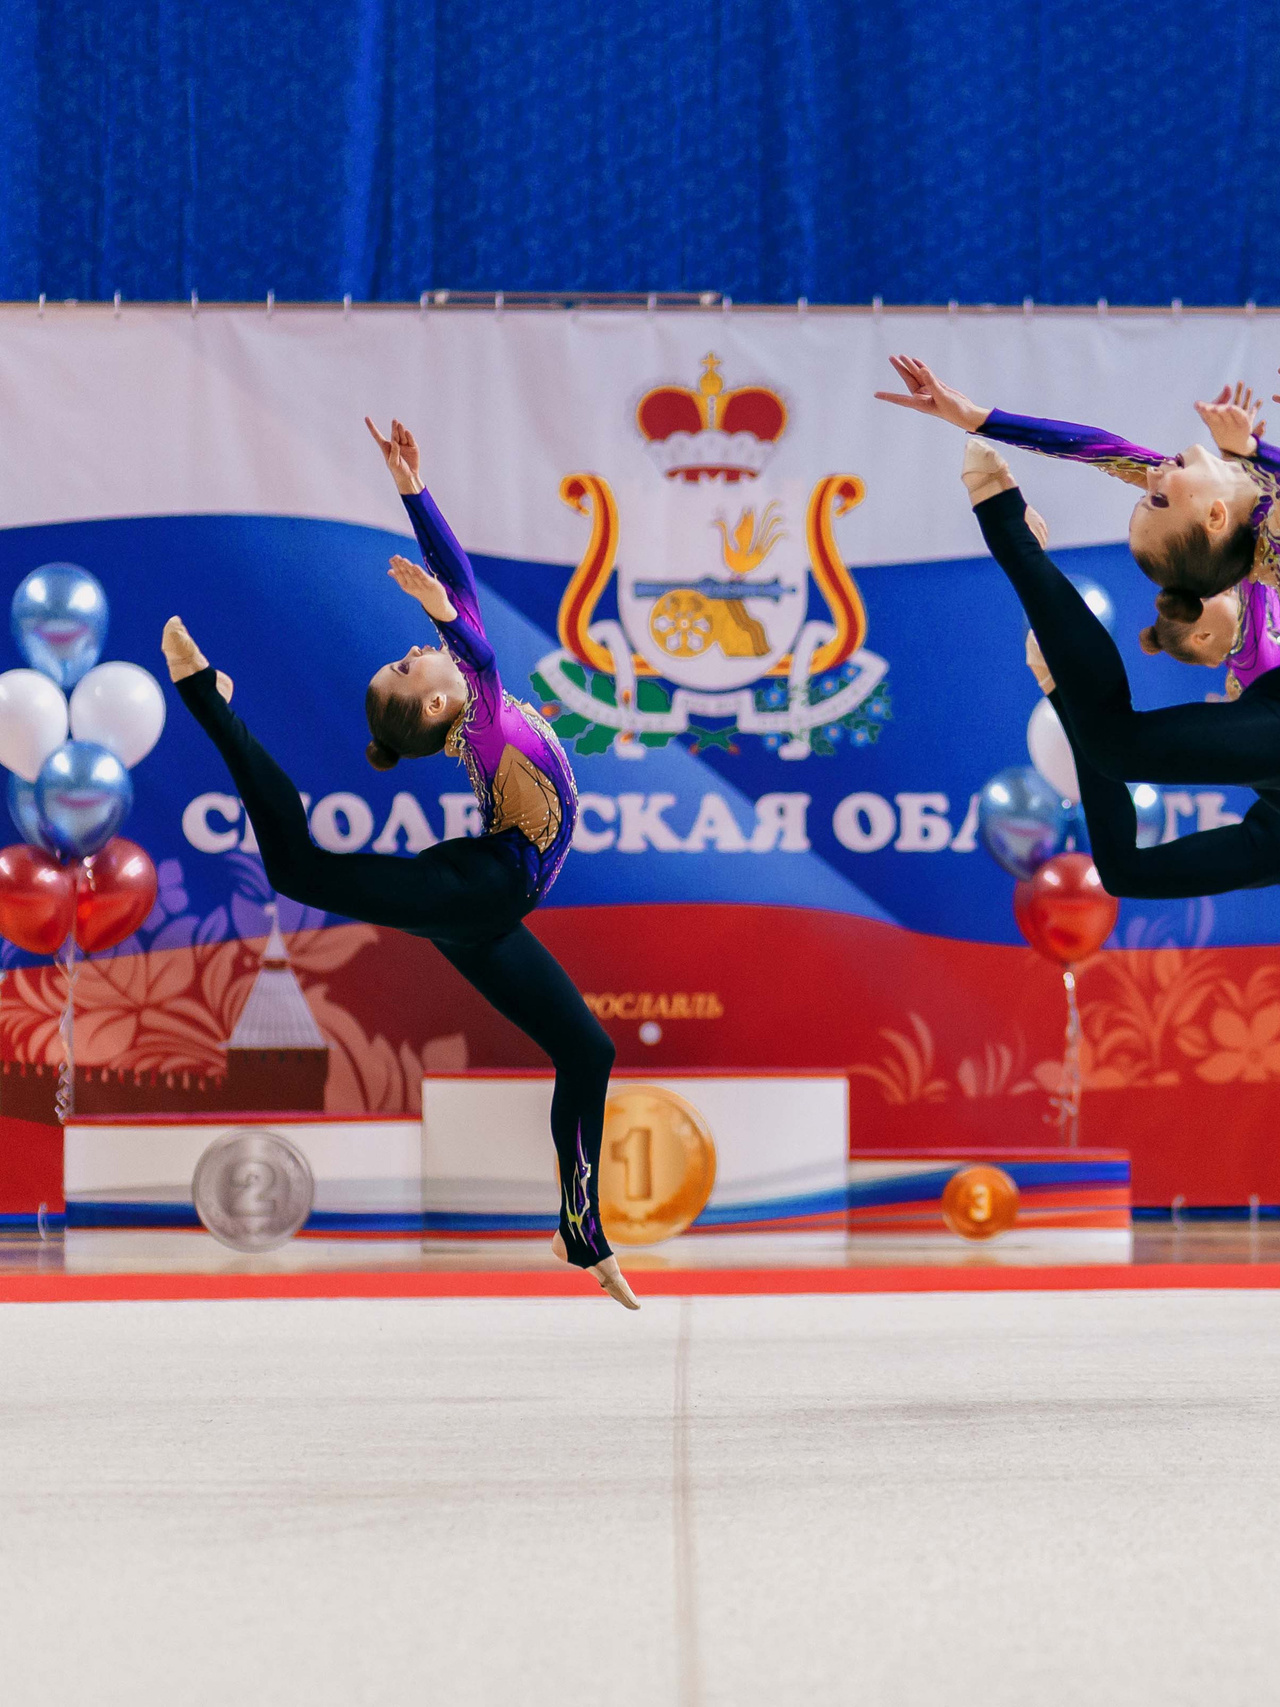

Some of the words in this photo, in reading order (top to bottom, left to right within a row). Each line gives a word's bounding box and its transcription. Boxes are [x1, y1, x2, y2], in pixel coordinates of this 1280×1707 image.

[182, 792, 811, 854] СОЛЕСКАЯ
[231, 1159, 277, 1217] 2
[610, 1127, 652, 1202] 1
[969, 1184, 991, 1222] 3
